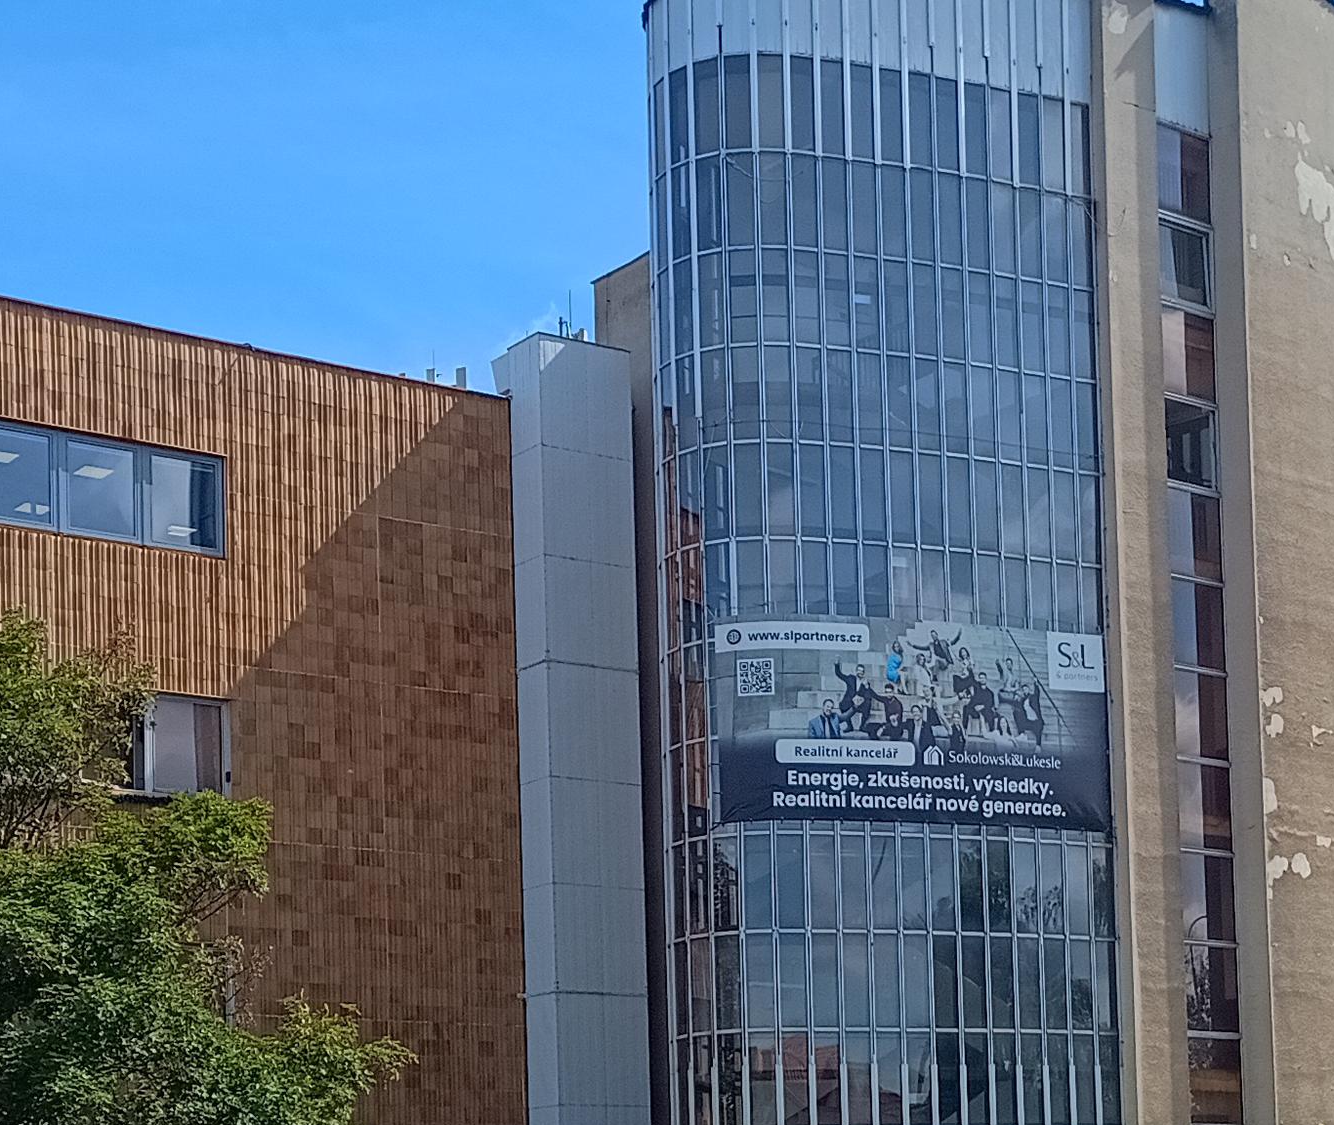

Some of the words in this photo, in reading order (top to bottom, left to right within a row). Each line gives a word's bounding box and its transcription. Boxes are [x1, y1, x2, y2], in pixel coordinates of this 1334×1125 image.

[748, 630, 862, 644] www.slpartners.cz
[1058, 641, 1095, 669] S&L
[794, 746, 842, 758] Realitní
[846, 747, 898, 758] kancelář
[787, 769, 864, 791] Energie,
[868, 770, 969, 793] zkušenosti,
[973, 775, 1054, 800] výsledky.
[773, 790, 846, 808] Realitní
[851, 792, 932, 810] kancelář
[936, 795, 979, 812] nové
[982, 800, 1067, 818] generace.
